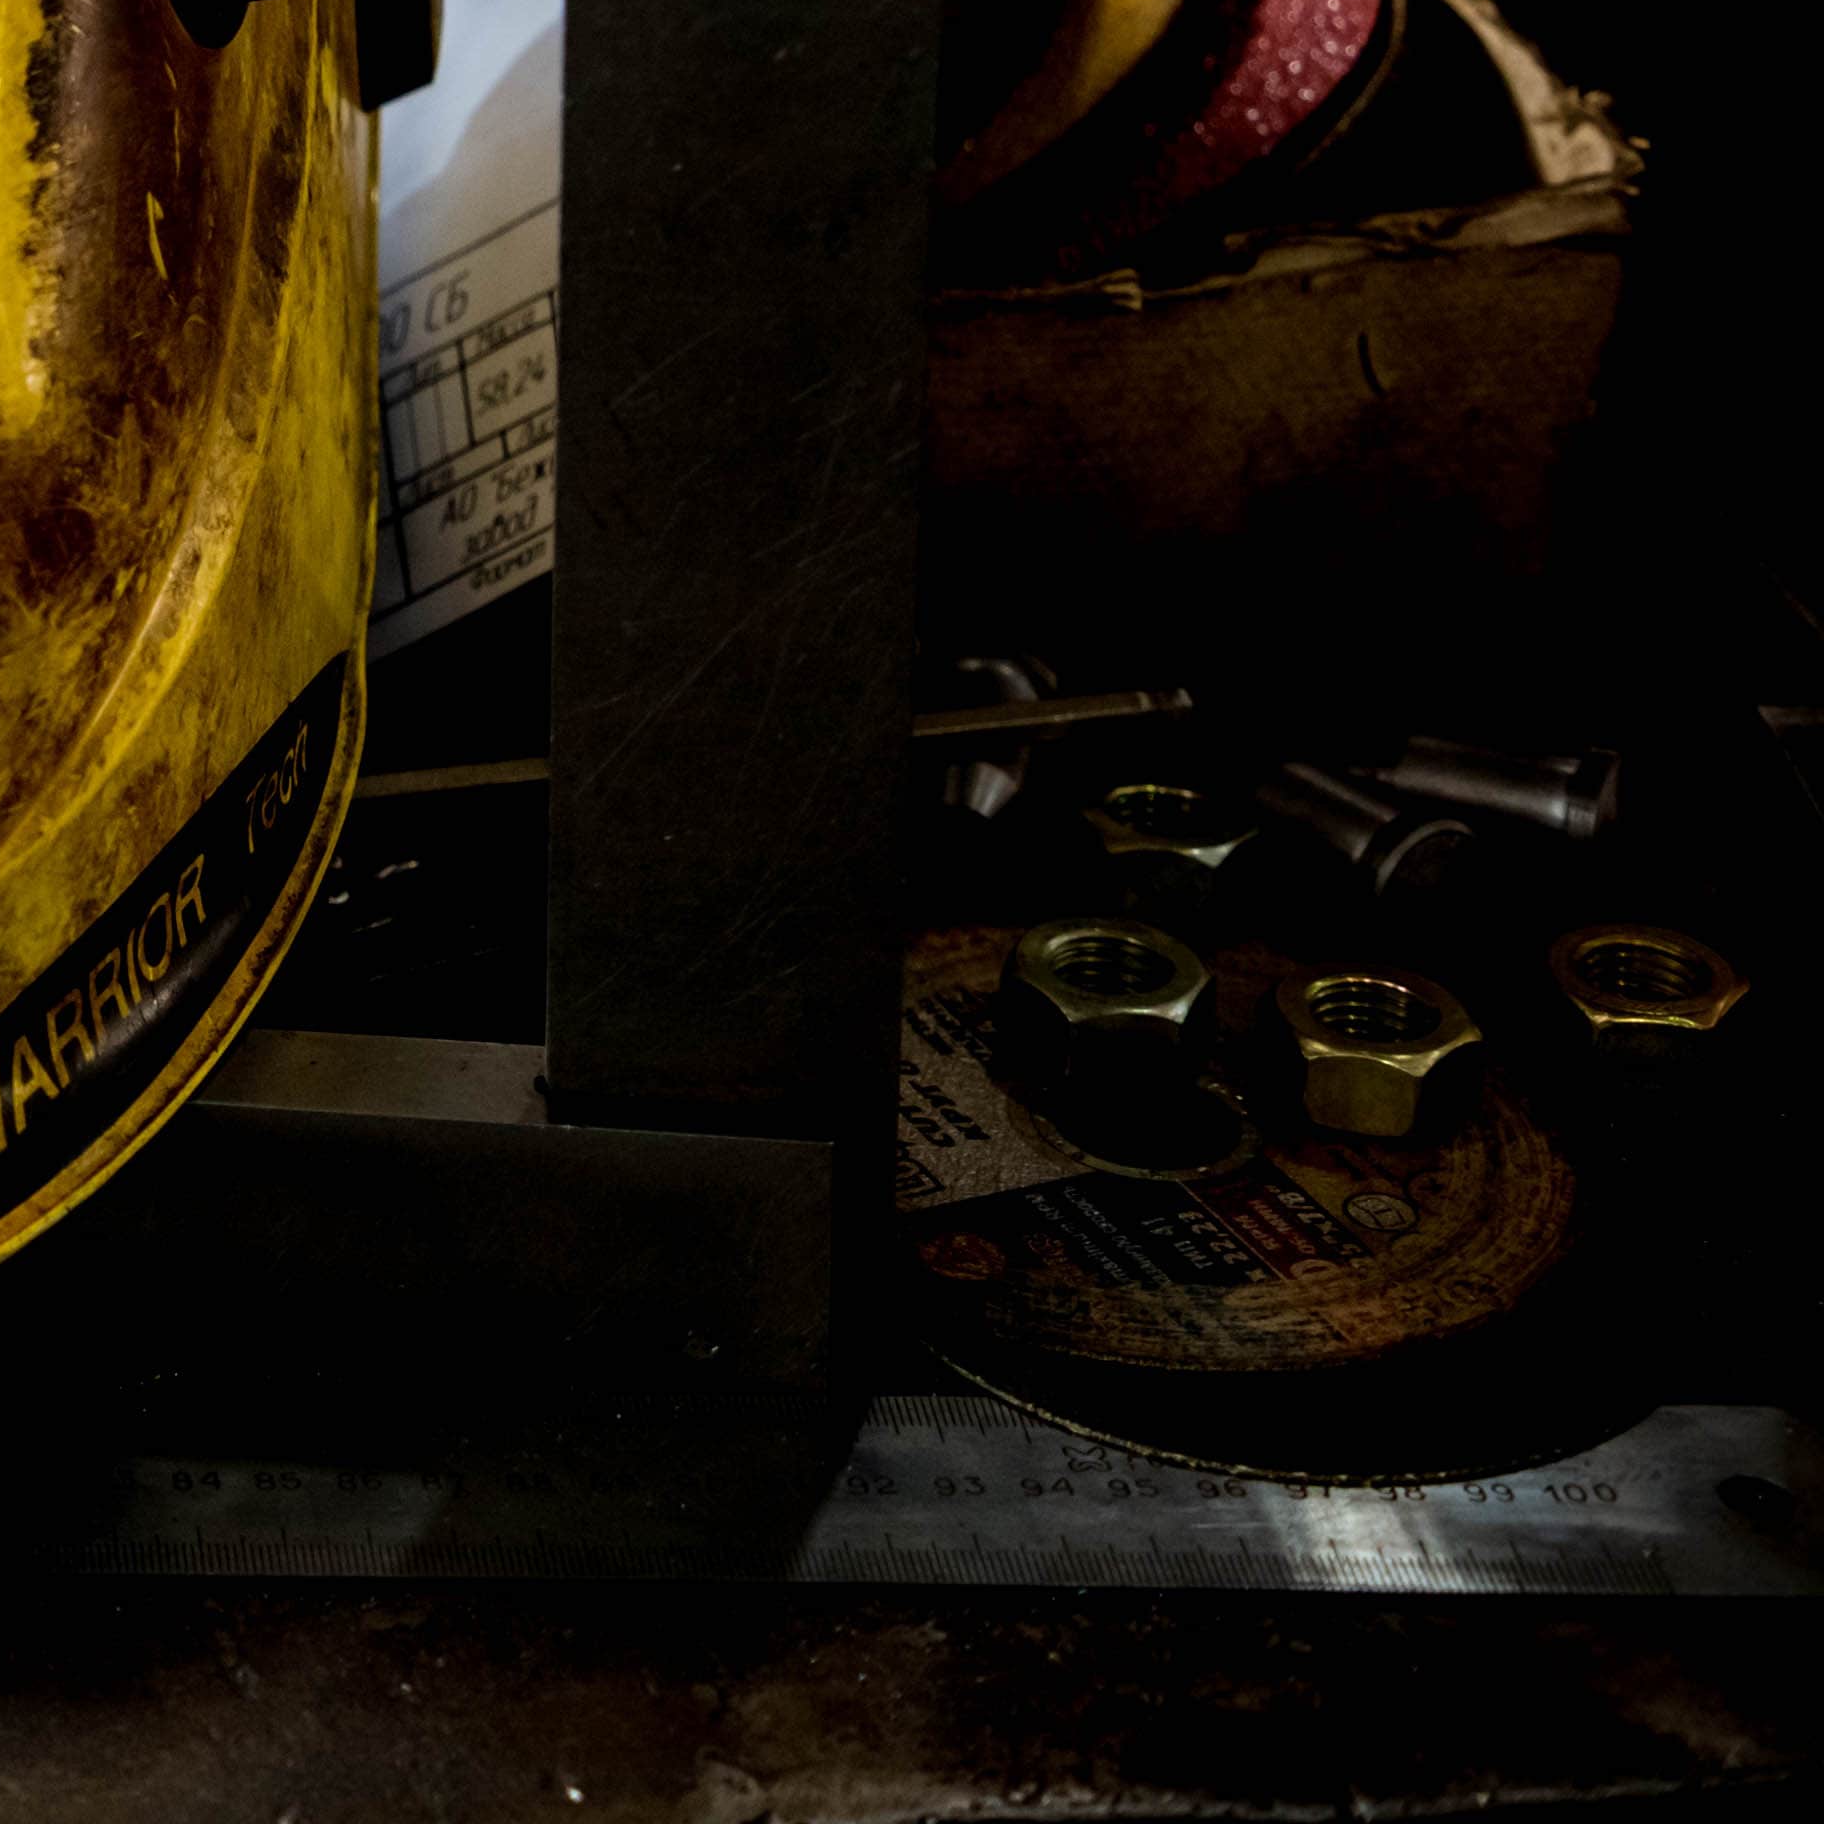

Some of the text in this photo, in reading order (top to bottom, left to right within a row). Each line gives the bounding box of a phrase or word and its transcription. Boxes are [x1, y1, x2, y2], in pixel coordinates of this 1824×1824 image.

[172, 1471, 222, 1492] 84
[253, 1471, 302, 1492] 85
[847, 1475, 898, 1497] 92
[933, 1475, 985, 1497] 93
[1020, 1476, 1074, 1498] 94
[1106, 1477, 1159, 1498] 95
[1195, 1478, 1248, 1500] 96
[1462, 1482, 1514, 1504] 99
[1543, 1481, 1618, 1504] 100
